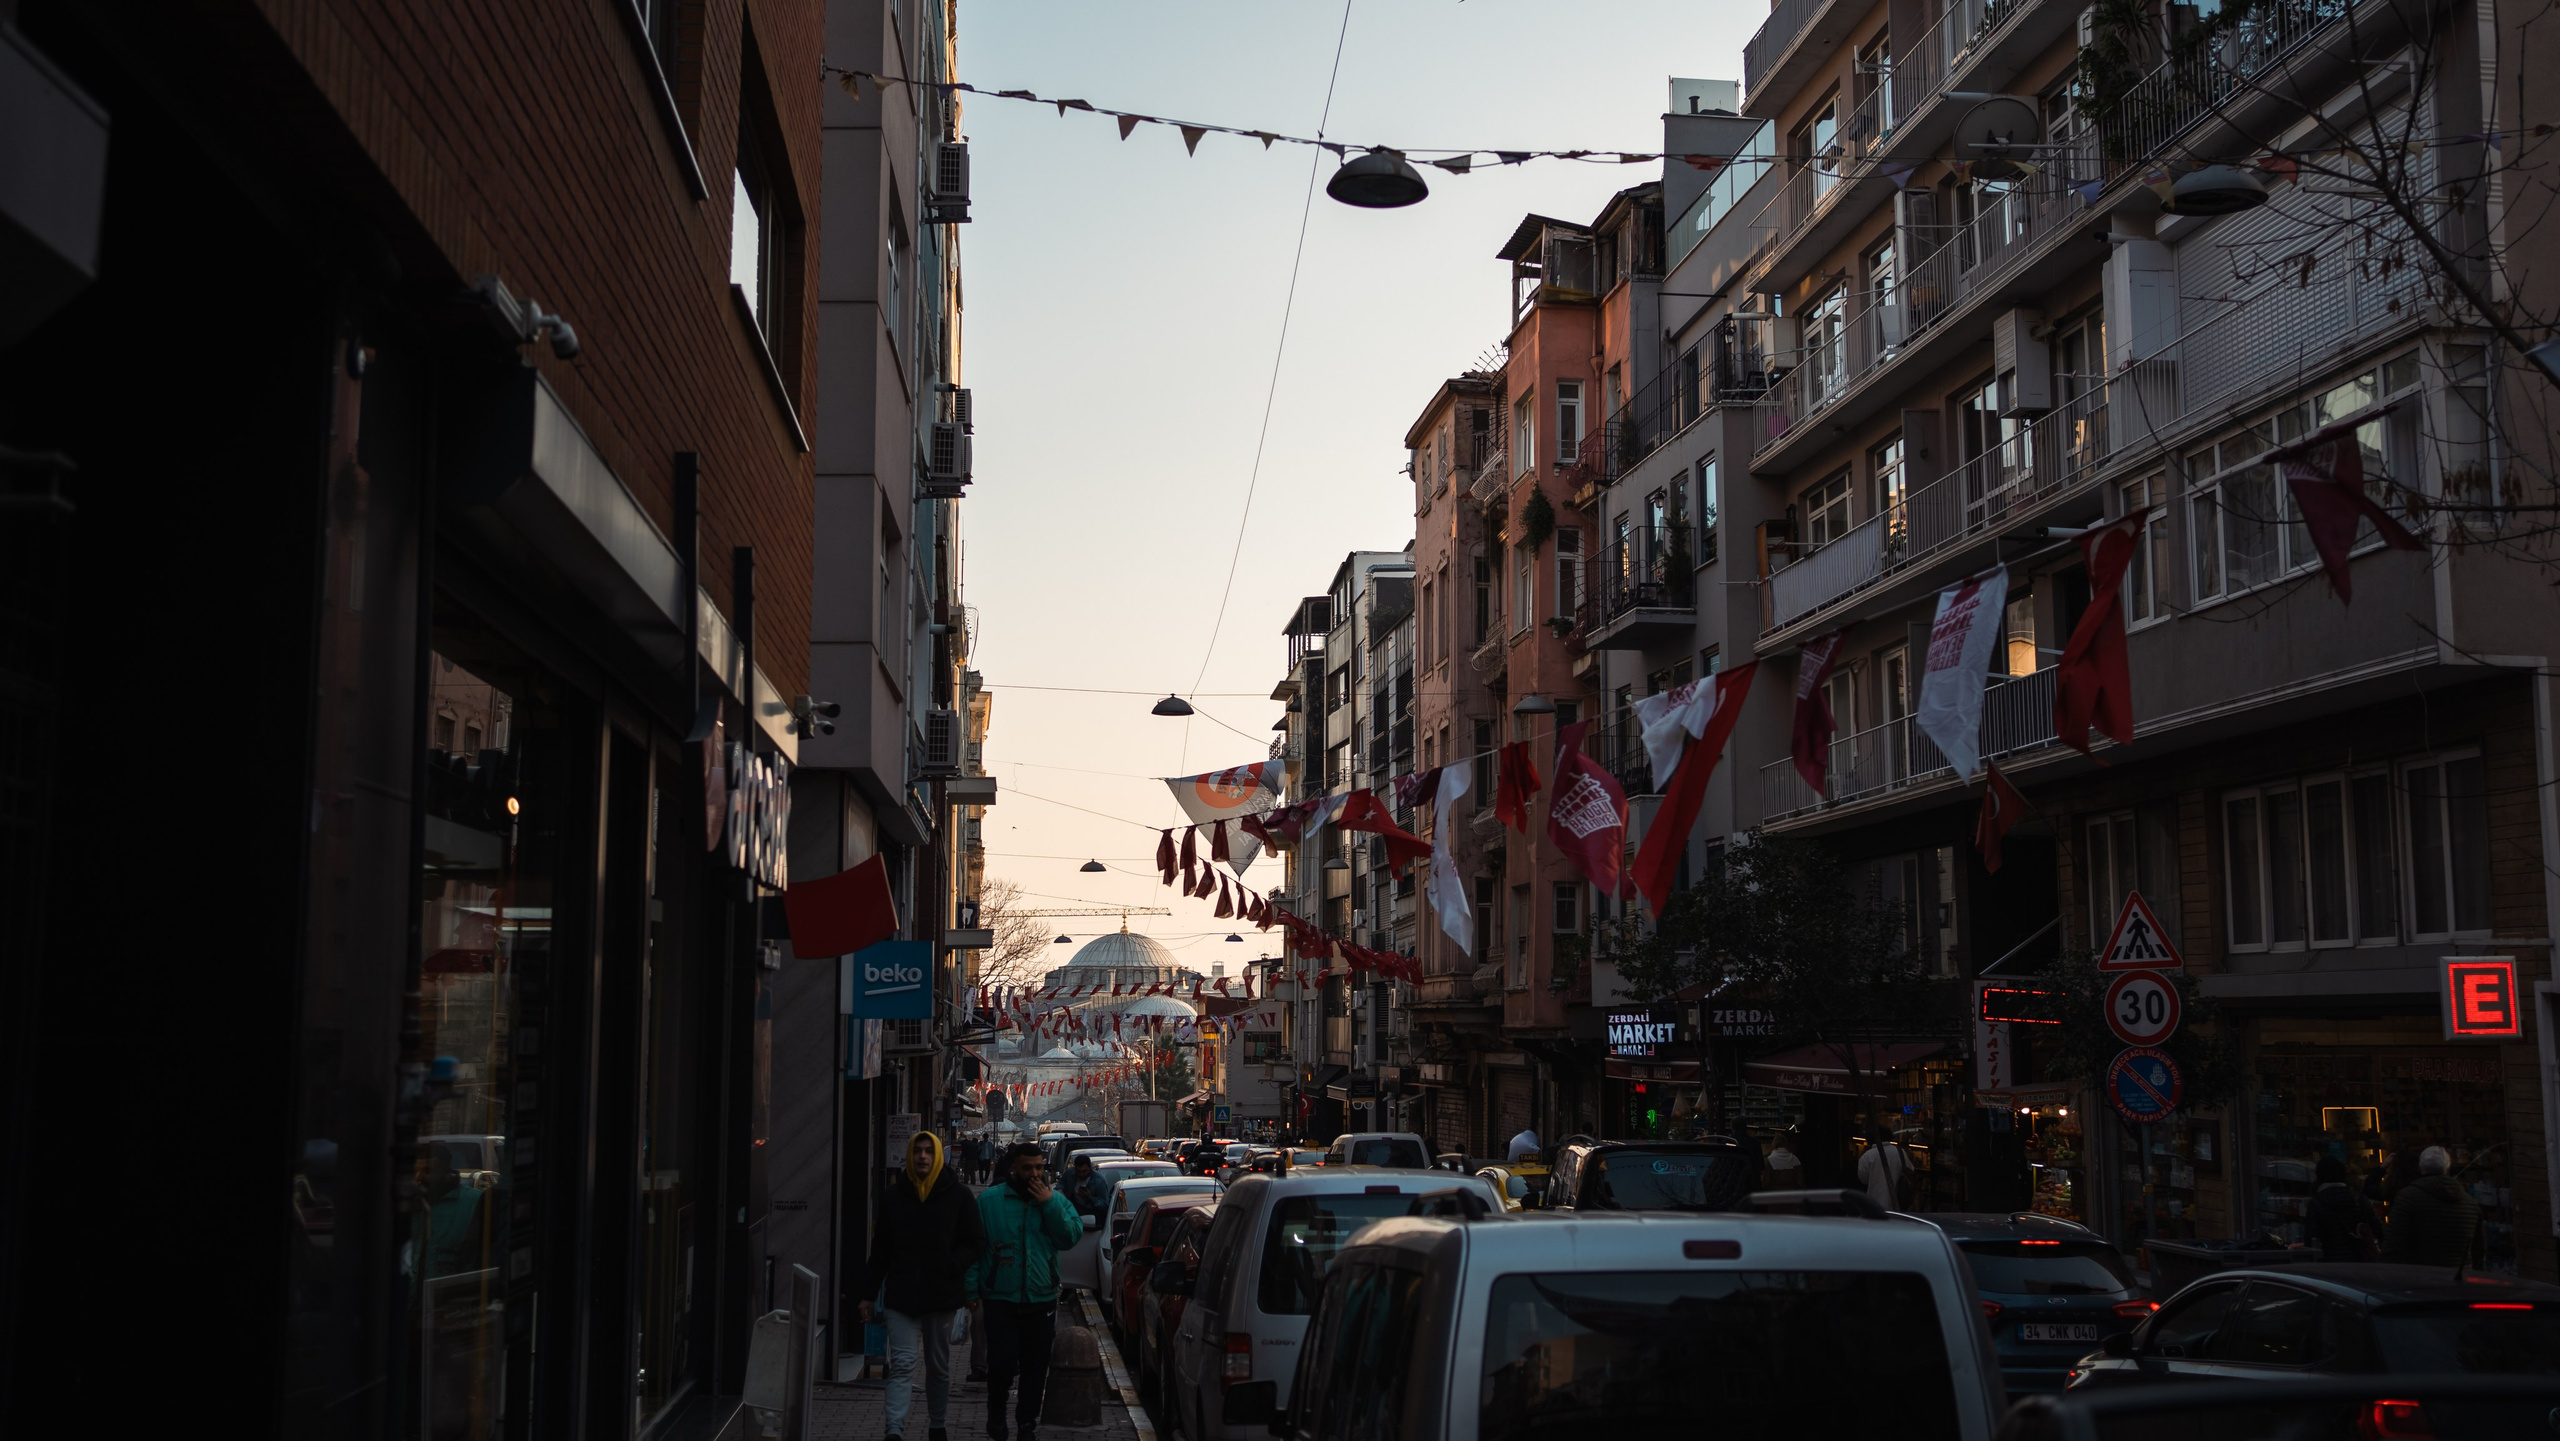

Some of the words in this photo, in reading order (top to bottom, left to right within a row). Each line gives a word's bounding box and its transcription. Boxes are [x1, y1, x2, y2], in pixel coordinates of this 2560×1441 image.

[864, 963, 923, 983] beko
[2120, 990, 2166, 1025] 30
[2463, 974, 2504, 1023] E
[1608, 1009, 1650, 1023] ZERDALİ
[1713, 1010, 1776, 1023] ZERDA
[1608, 1023, 1676, 1045] MARKET
[1722, 1024, 1784, 1036] MARKE
[2111, 1055, 2130, 1080] DERECE
[2169, 1066, 2180, 1085] YOLU
[2413, 1058, 2504, 1084] PHARMACY
[2117, 1103, 2136, 1120] PARK
[2138, 1101, 2176, 1122] YAPILMAZ
[2026, 1325, 2040, 1338] 34
[2048, 1325, 2070, 1339] CNK
[2074, 1325, 2095, 1339] 040
